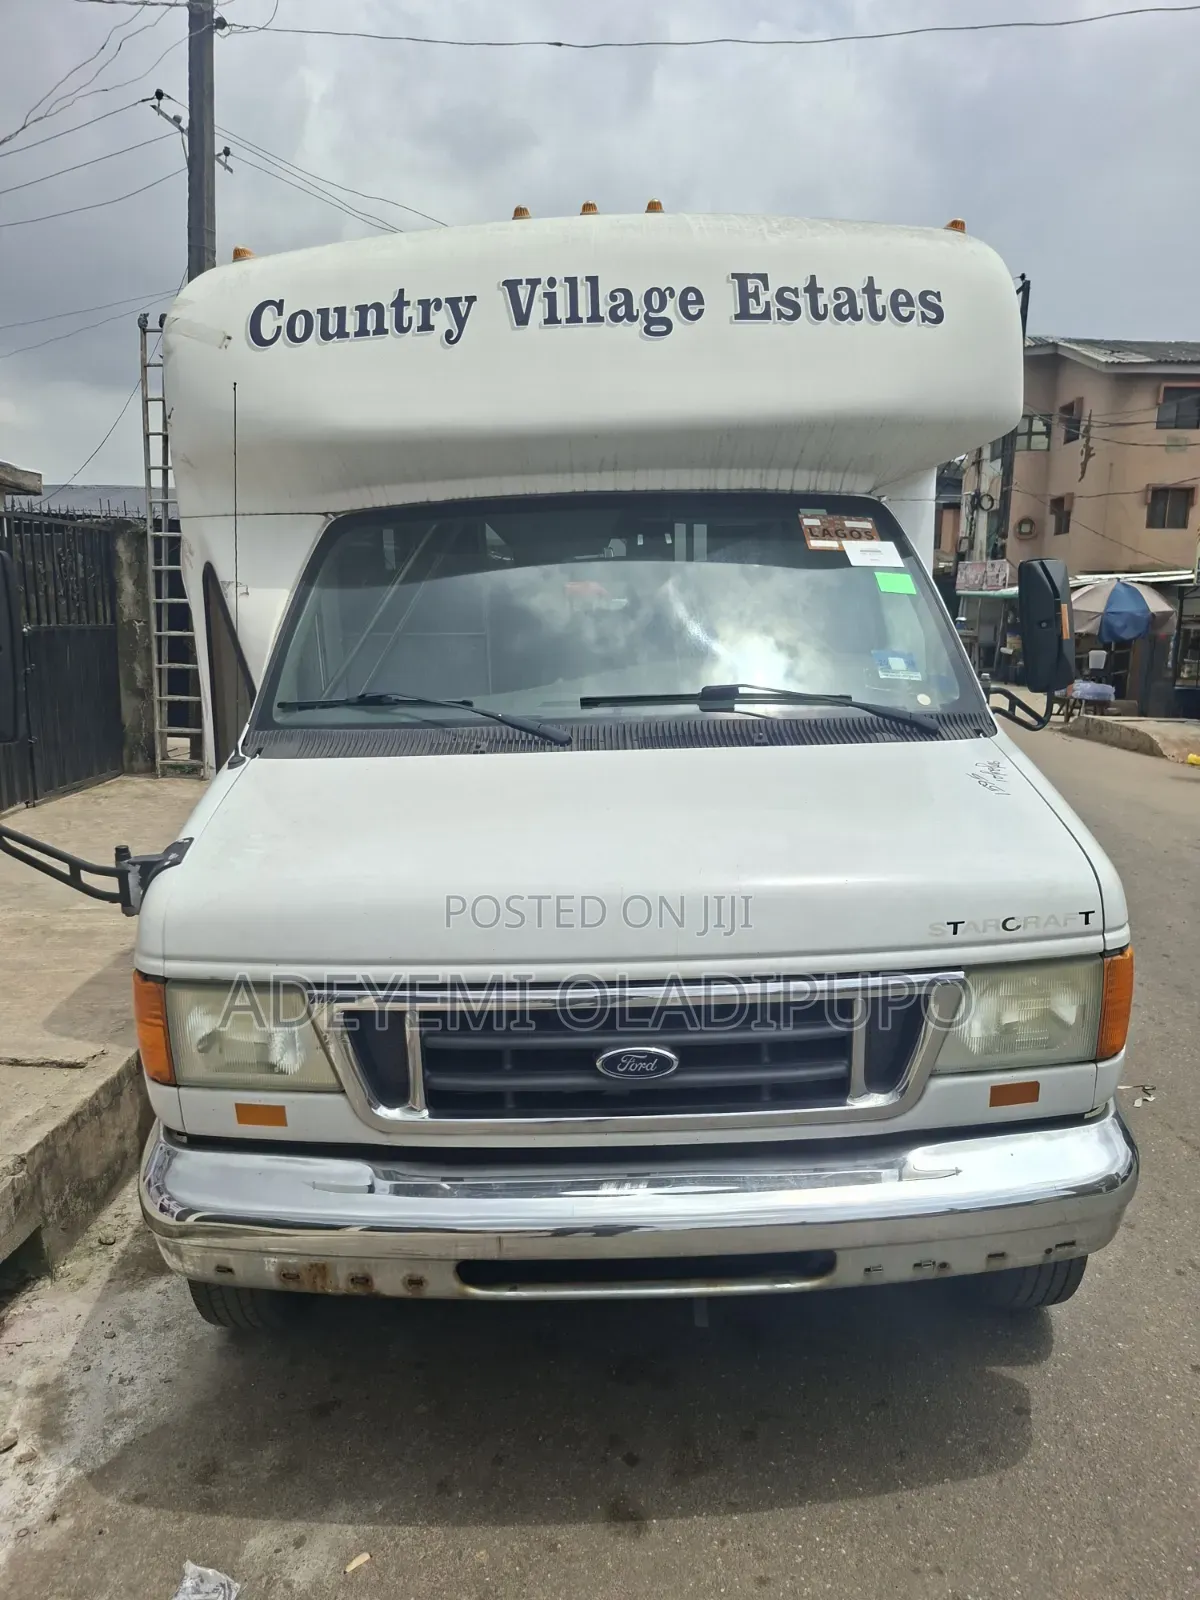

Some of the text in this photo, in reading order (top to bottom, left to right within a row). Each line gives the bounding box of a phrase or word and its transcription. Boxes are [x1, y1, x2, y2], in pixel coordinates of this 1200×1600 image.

[247, 271, 946, 348] Country Village Estates
[808, 527, 875, 541] LAGOS
[928, 910, 1095, 937] STARCRAFT
[617, 1054, 658, 1071] Ford
